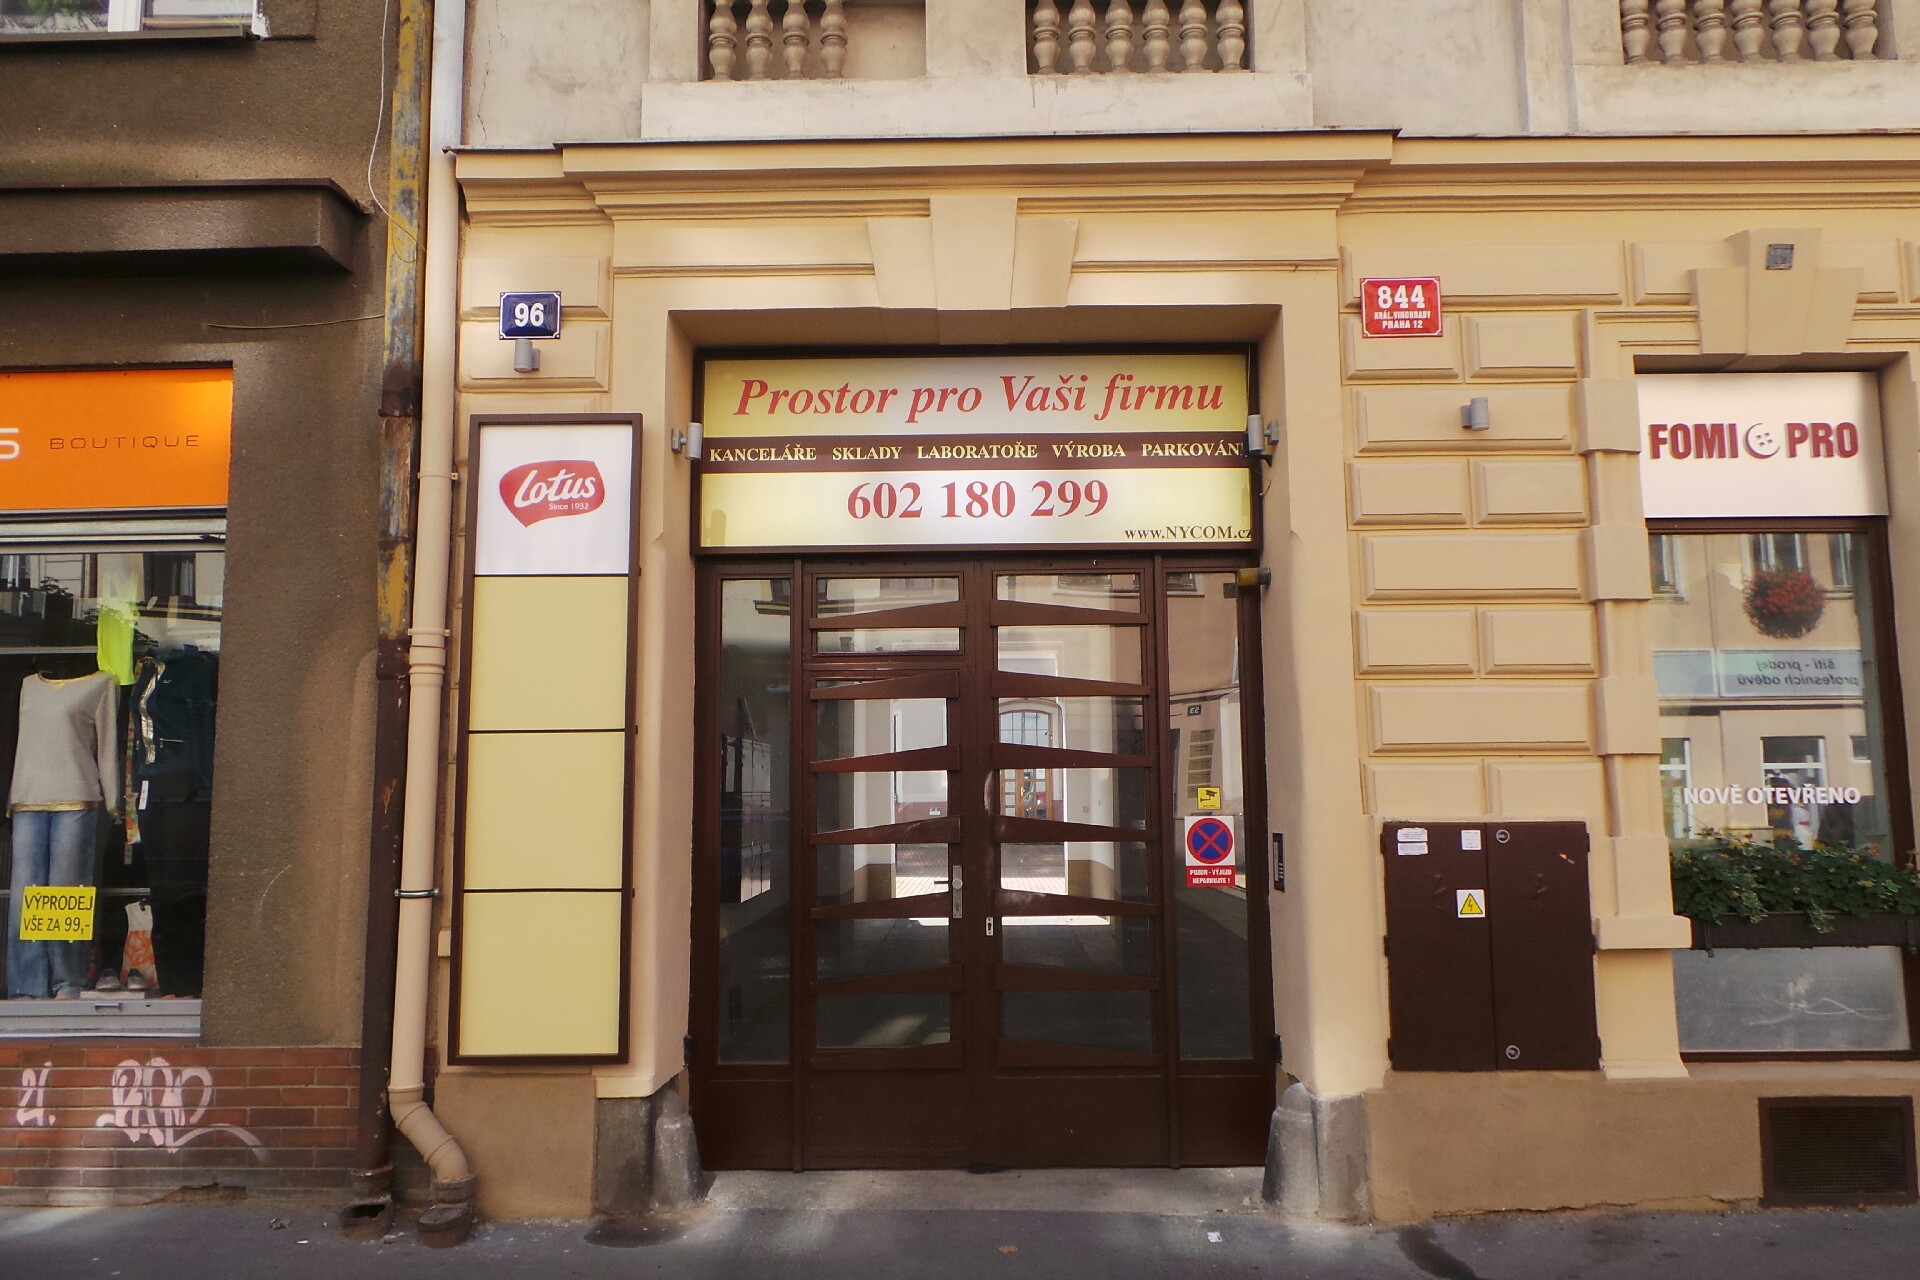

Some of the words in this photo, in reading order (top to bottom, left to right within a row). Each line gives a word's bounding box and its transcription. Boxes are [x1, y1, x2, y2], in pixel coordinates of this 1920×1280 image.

[1377, 284, 1426, 309] 844
[514, 302, 545, 327] 96
[1382, 320, 1411, 329] PRAHA
[1413, 319, 1423, 329] 12
[733, 379, 898, 415] Prostor
[905, 386, 982, 423] pro
[1000, 374, 1088, 412] Vaši
[1093, 373, 1223, 421] firmu
[50, 434, 200, 450] BOUTIQUE
[709, 444, 817, 462] KANCELÁŘE
[832, 446, 903, 461] SKLADY
[917, 441, 1038, 460] LABORATOŘE
[1051, 440, 1126, 459] VÝROBA
[1141, 439, 1244, 458] PARKOVÁN
[1649, 422, 1739, 460] FOMI
[1785, 421, 1859, 459] PRO
[513, 468, 596, 508] Lotus
[847, 482, 923, 519] 602
[940, 481, 1016, 518] 180
[1030, 479, 1108, 518] 299
[548, 502, 568, 511] Since
[571, 502, 589, 510] 1932
[1124, 525, 1253, 540] www.NYCOM.cz
[1684, 784, 1742, 805] NOVĚ
[1747, 783, 1861, 805] OTEVŘENO
[24, 892, 94, 911] VÝPRODEJ
[24, 915, 43, 932] VŠE
[47, 918, 61, 932] ZA
[65, 916, 91, 935] 99,-
